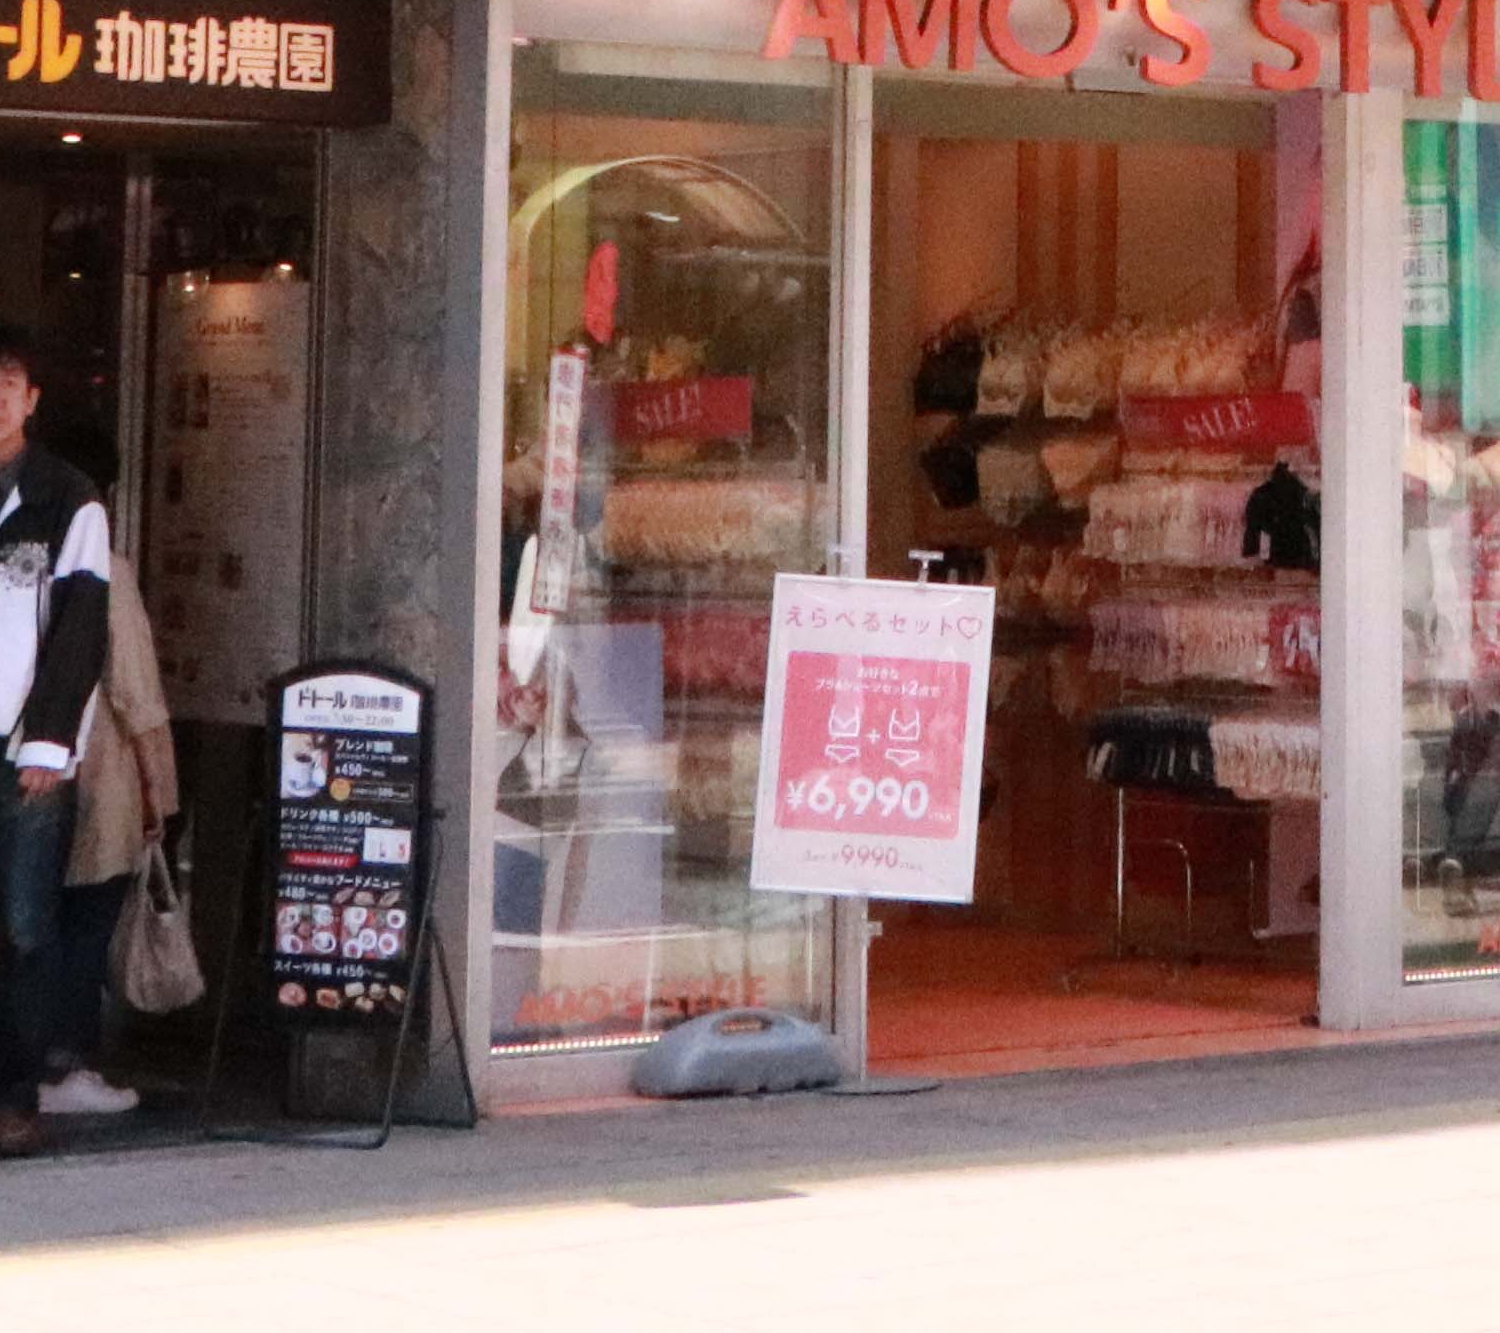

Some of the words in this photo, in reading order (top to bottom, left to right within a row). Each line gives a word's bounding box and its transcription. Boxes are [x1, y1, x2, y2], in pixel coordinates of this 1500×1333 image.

[94, 9, 334, 93] 珈琲農園
[785, 605, 953, 638] えらべるセット
[297, 684, 348, 709] ドトール
[785, 774, 930, 821] ¥6,990
